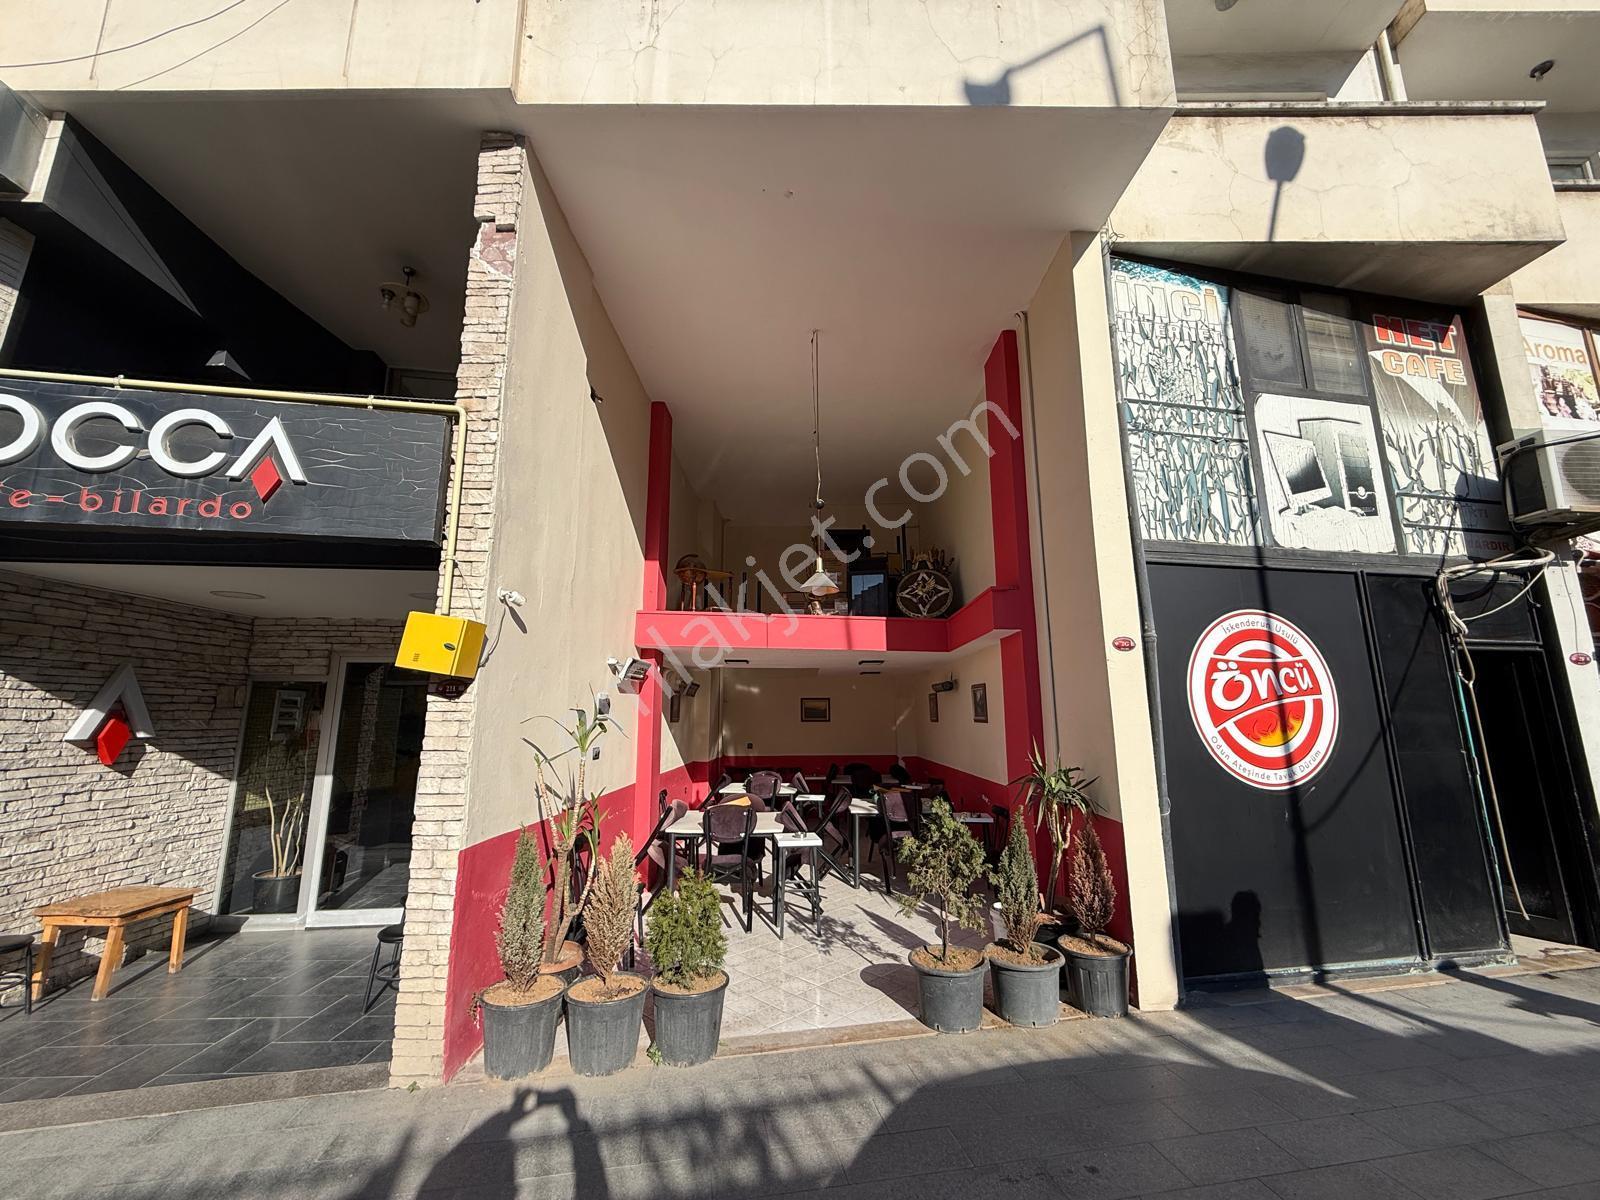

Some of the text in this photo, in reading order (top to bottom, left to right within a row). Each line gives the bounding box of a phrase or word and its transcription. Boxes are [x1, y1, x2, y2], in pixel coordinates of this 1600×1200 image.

[1373, 314, 1457, 353] NET
[1522, 336, 1588, 364] Aroma
[1381, 350, 1467, 385] CAFE
[0, 484, 252, 520] e-bilardo
[1221, 619, 1300, 645] İskenderun Usulü
[1211, 736, 1231, 761] Odun
[1231, 759, 1272, 781] Ateşinde
[1298, 749, 1322, 774] Dürüm
